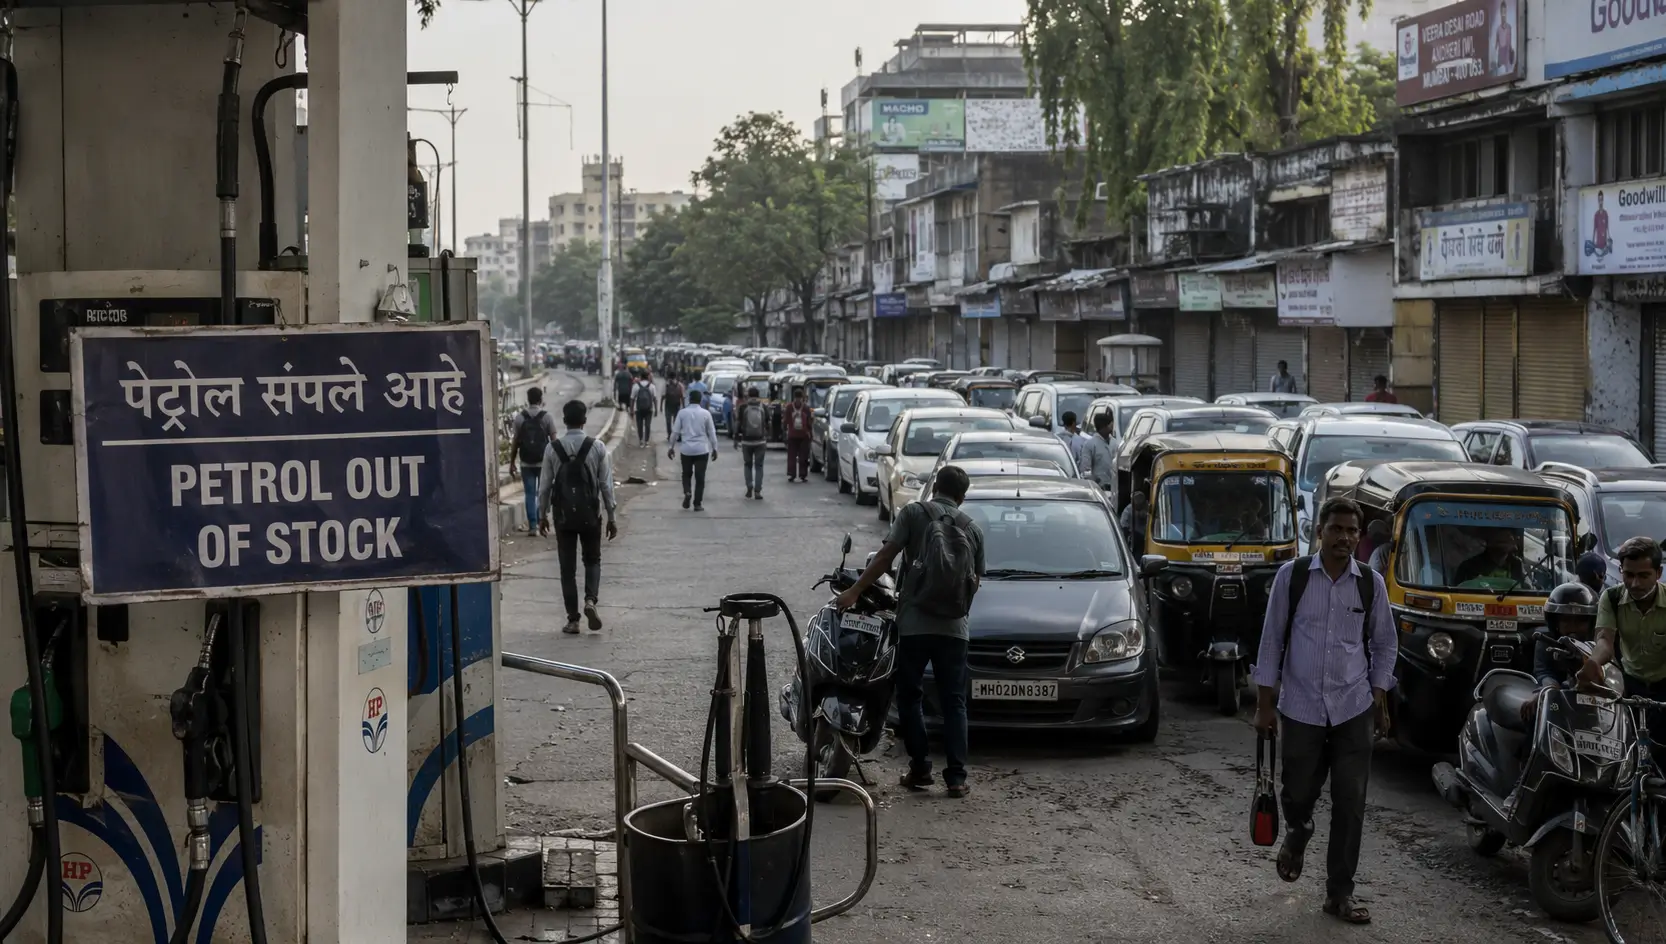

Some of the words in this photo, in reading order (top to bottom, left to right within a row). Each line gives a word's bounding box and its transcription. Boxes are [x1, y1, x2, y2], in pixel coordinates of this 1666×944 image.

[1618, 185, 1666, 207] Goodwill
[119, 360, 245, 431] पेट्रोल
[256, 356, 368, 416] संपले
[383, 353, 467, 416] आहे
[171, 459, 332, 507] PETROL
[346, 455, 425, 499] OUT
[198, 523, 251, 569] OF
[265, 516, 403, 565] STOCK
[980, 683, 1056, 697] MH02DN8387
[368, 696, 383, 719] HP
[62, 861, 92, 880] HP
